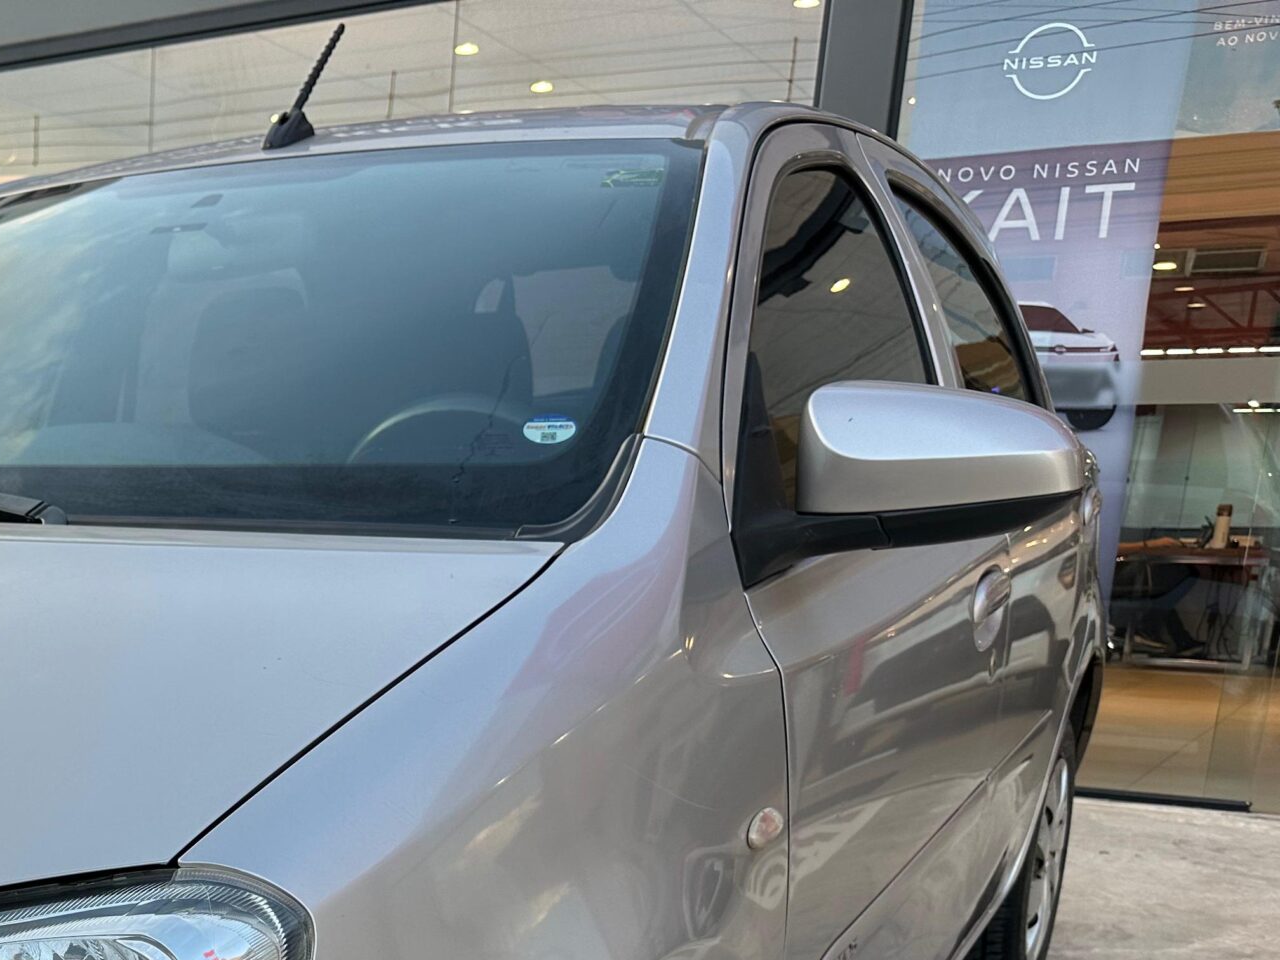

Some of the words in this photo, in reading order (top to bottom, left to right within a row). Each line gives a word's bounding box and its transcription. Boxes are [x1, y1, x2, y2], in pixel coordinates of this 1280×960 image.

[1216, 36, 1238, 47] AO
[1003, 51, 1098, 71] NISSAN
[938, 165, 1016, 183] NOVO
[1033, 158, 1141, 179] NISSAN
[962, 182, 1136, 243] AIT
